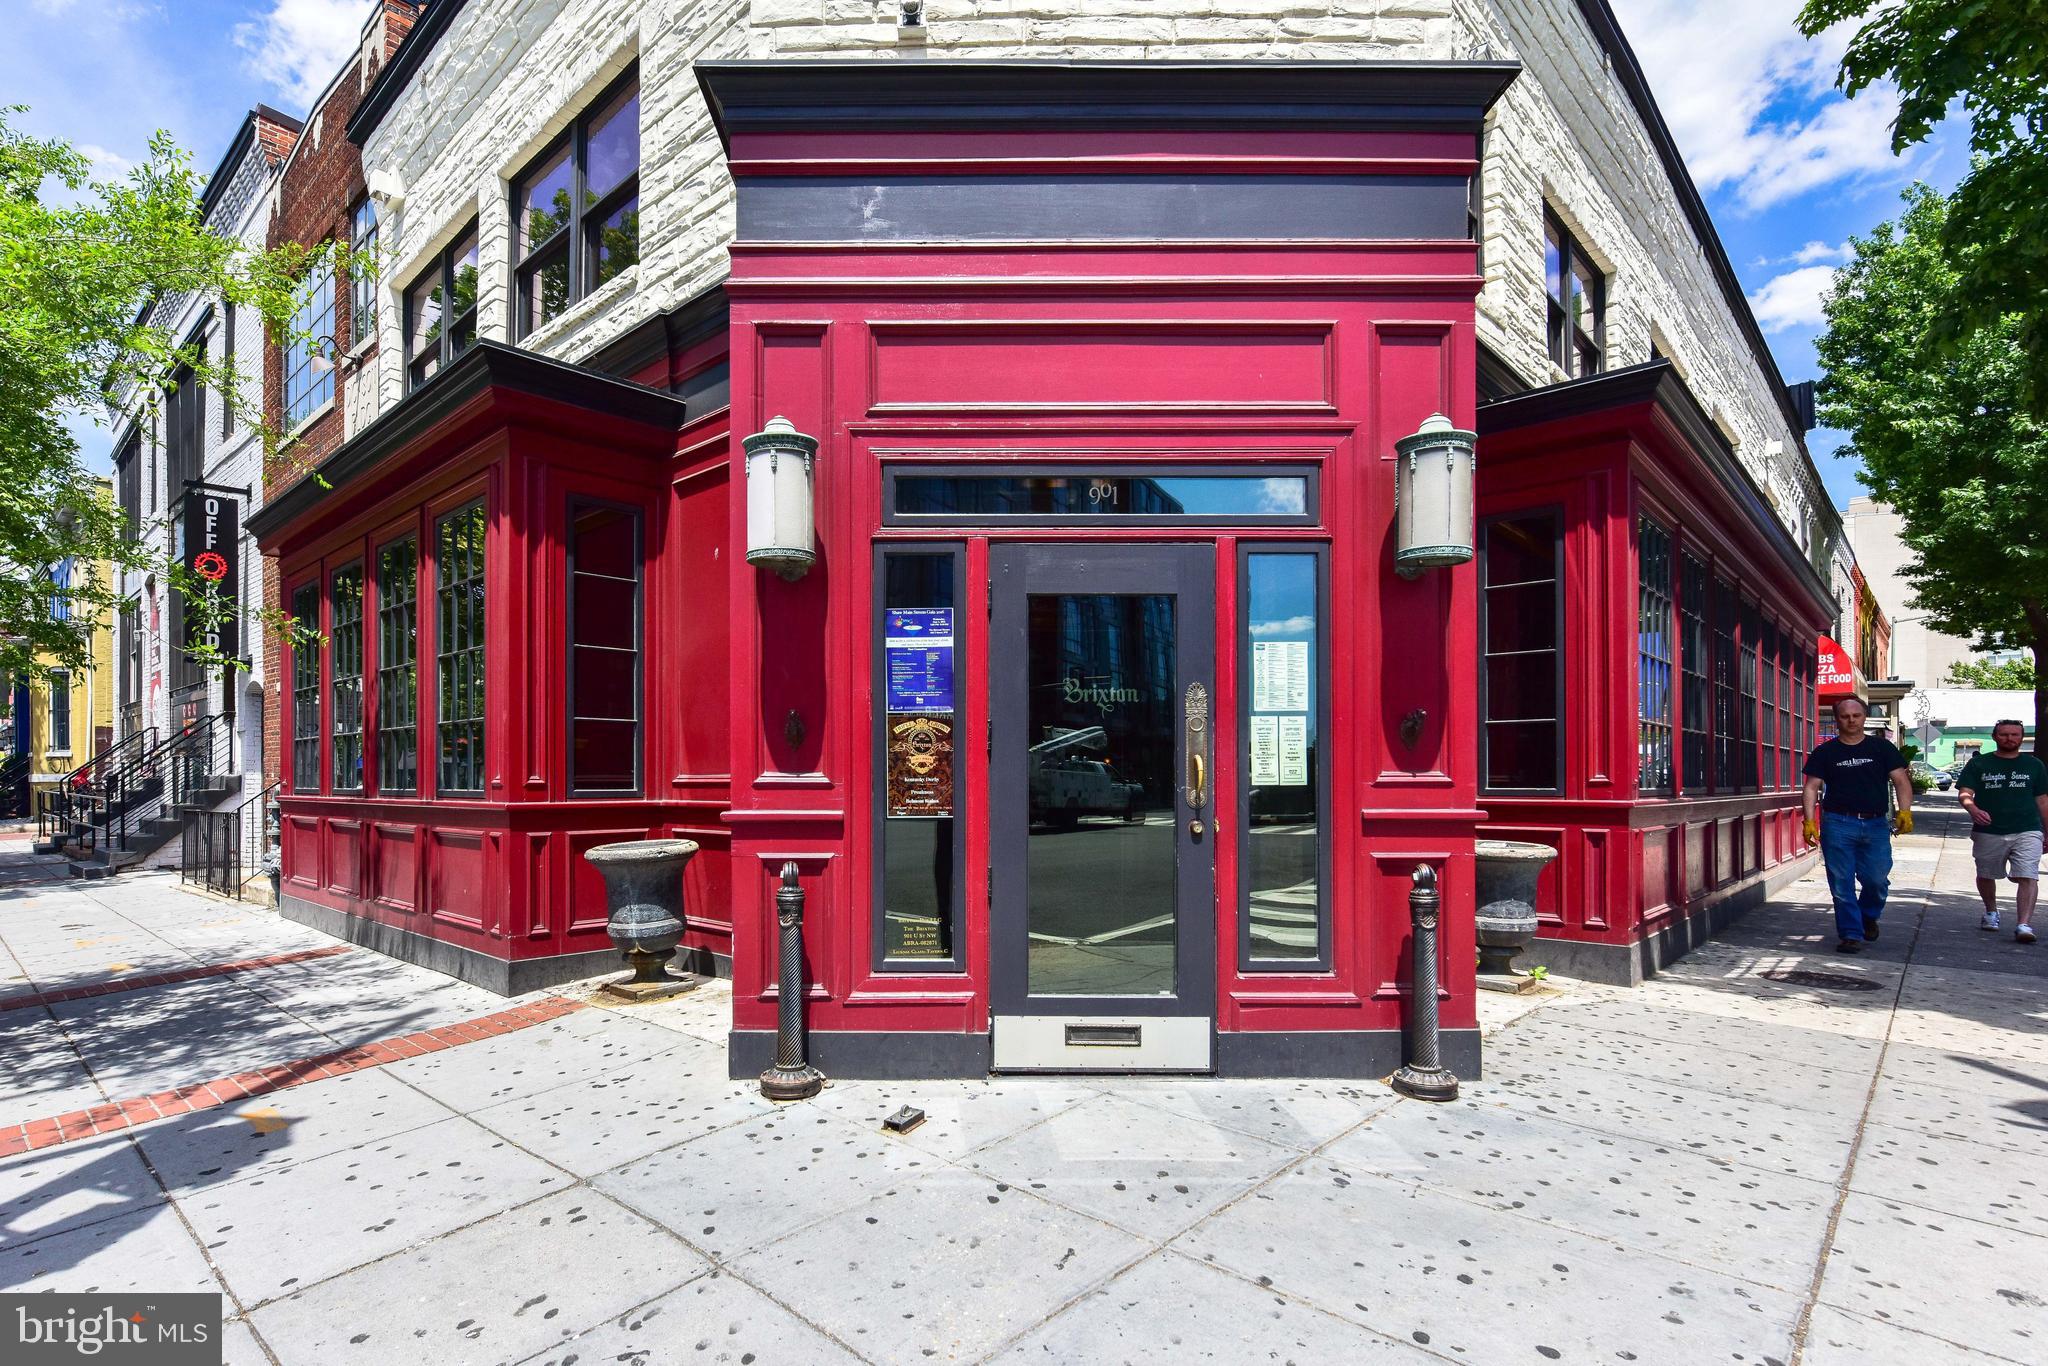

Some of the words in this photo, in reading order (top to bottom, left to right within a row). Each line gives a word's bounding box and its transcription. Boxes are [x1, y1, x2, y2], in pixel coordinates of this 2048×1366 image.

[1089, 483, 1118, 505] 901
[205, 498, 219, 550] OFF
[1828, 673, 1851, 684] FOOD
[1063, 677, 1139, 719] Brixton
[2010, 771, 2030, 780] Senior
